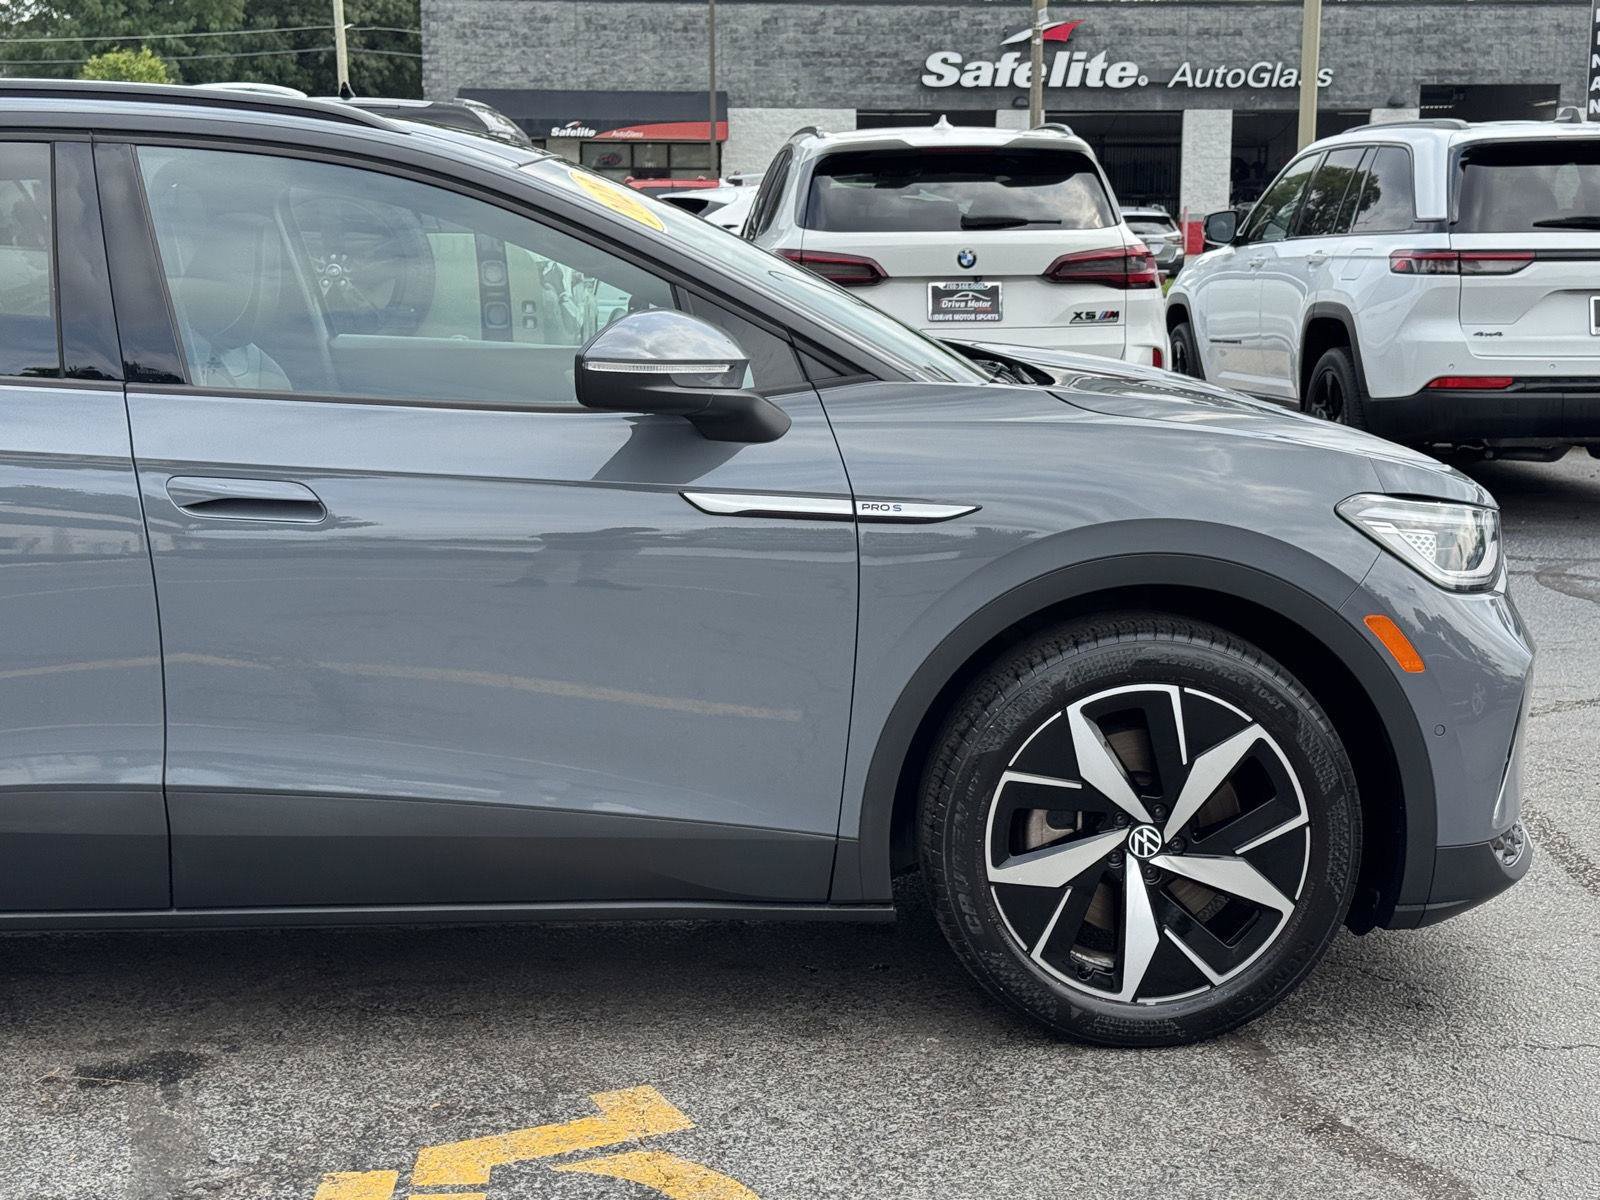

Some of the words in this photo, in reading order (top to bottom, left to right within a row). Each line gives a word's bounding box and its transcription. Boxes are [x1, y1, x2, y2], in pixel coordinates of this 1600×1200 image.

[921, 49, 1139, 89] Safelite
[1167, 61, 1335, 89] AutoGlas
[551, 126, 597, 138] Safelite
[941, 300, 966, 308] Drive
[967, 299, 993, 308] Motor
[953, 313, 976, 321] MOTOR
[976, 313, 999, 321] SPORTS
[1072, 311, 1097, 321] X5
[861, 503, 891, 512] PRO
[892, 504, 902, 512] S
